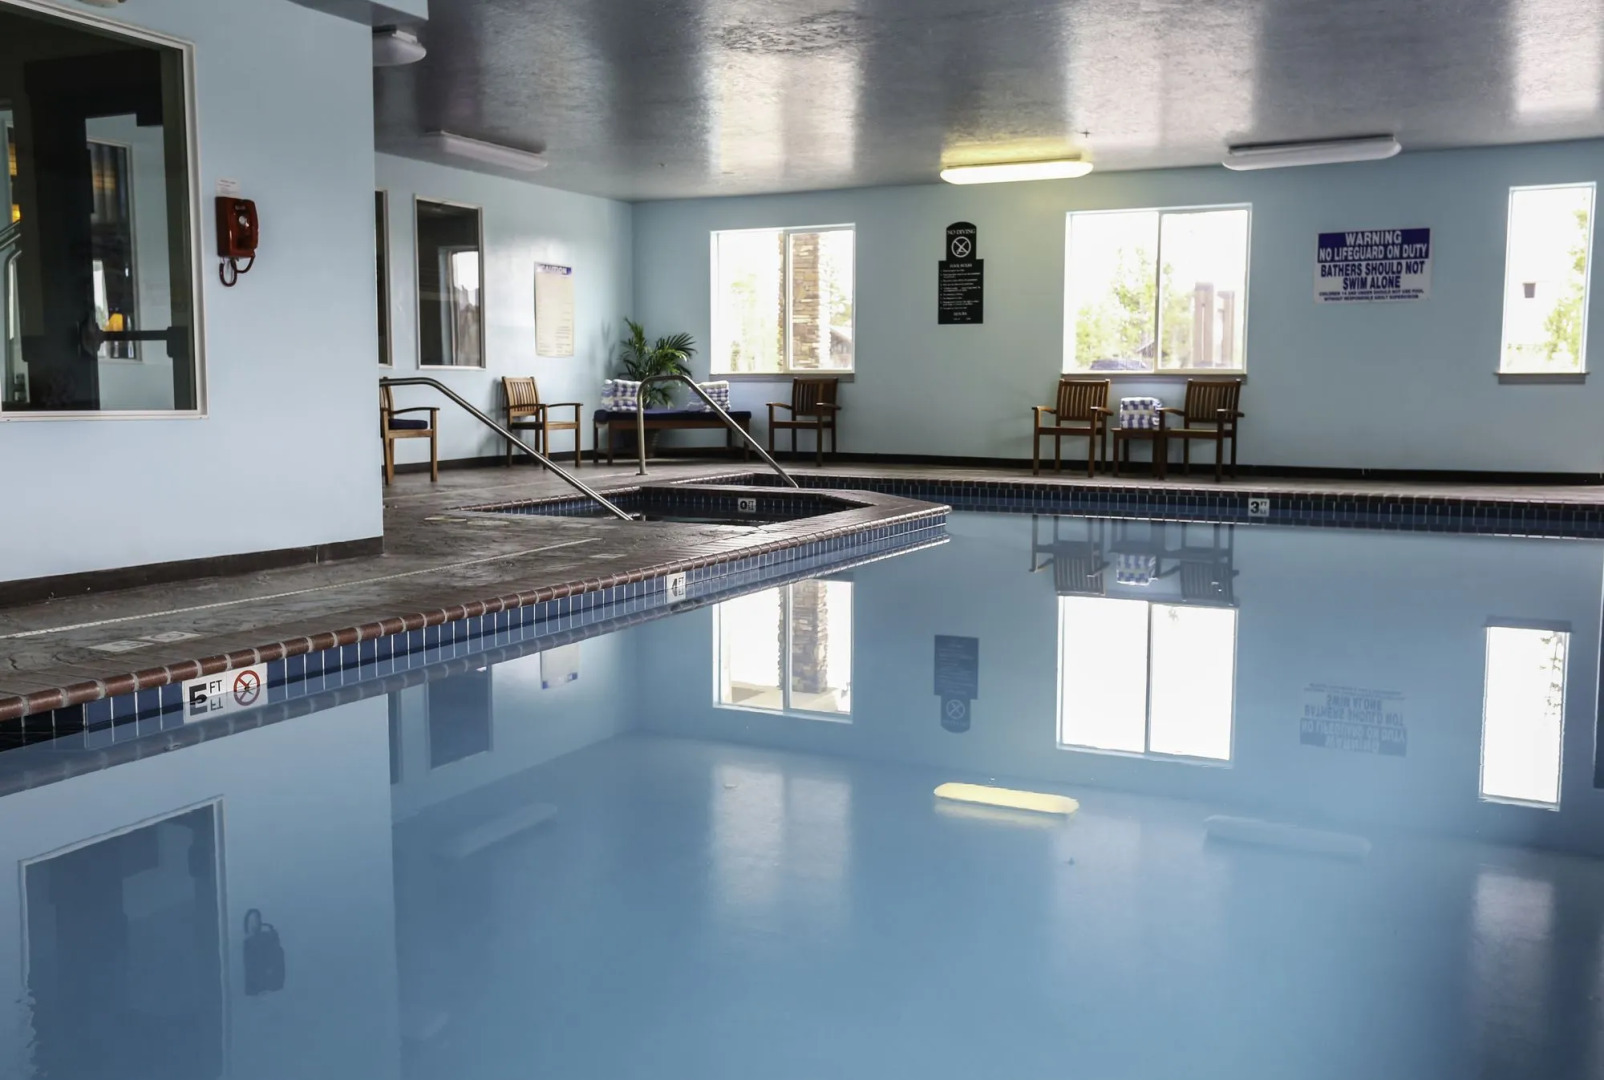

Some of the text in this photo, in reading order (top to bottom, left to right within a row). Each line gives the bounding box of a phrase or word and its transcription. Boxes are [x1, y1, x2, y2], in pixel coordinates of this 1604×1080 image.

[1346, 231, 1402, 246] WARNING
[1319, 244, 1427, 261] NO LIFEGUARD ON DUTY
[1321, 261, 1425, 277] BATHERS SHOULD NOT
[1343, 276, 1401, 290] SWIM ALONE
[1251, 501, 1259, 514] 3
[189, 680, 222, 705] 5 FT
